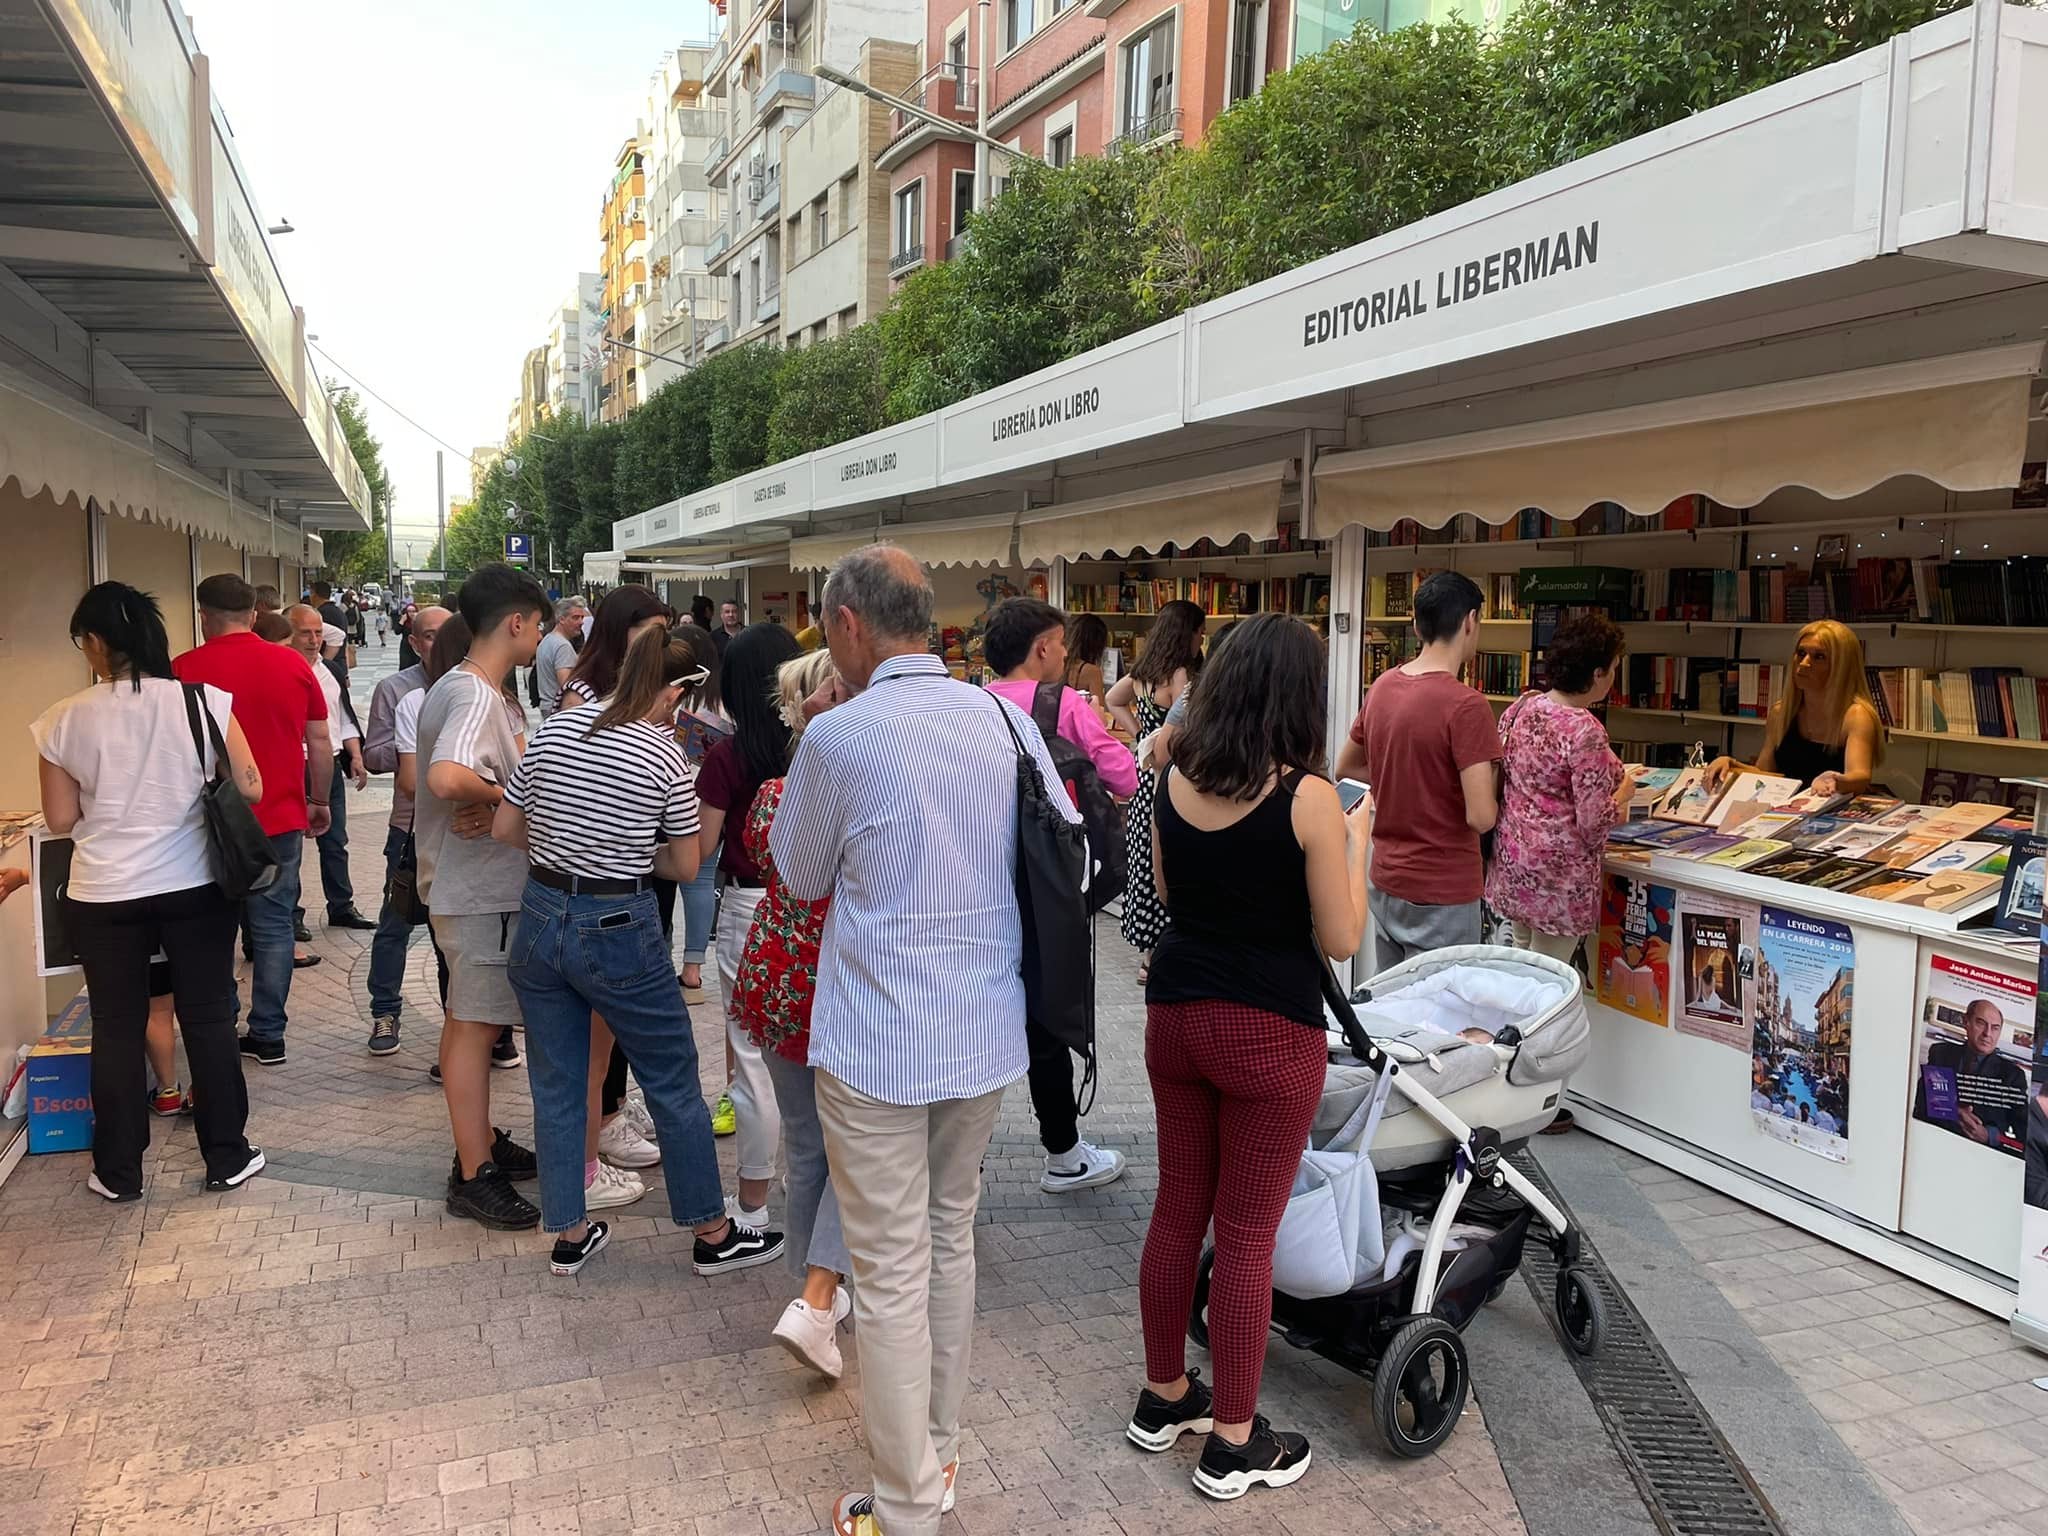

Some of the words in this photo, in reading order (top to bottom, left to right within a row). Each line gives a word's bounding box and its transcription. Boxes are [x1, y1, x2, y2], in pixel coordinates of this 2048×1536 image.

[1304, 279, 1427, 347] EDITORIAL
[1436, 220, 1599, 309] LIBERMAN
[992, 406, 1036, 442] LIBRERÍA
[1039, 399, 1061, 429] DON
[1065, 387, 1100, 420] LIBRO
[841, 456, 865, 482] LIBRERÍA
[865, 458, 878, 476] DON
[878, 452, 897, 472] LIBRO
[511, 537, 522, 552] P
[1537, 581, 1589, 592] salamandra
[1627, 879, 1648, 906] 35
[1696, 929, 1705, 938] LA
[1787, 919, 1826, 934] LEYENDO
[1696, 938, 1708, 947] DEL
[1762, 928, 1774, 937] EN
[1775, 931, 1786, 940] LA
[1787, 934, 1826, 948] CARRERA
[1829, 942, 1851, 953] 2019
[1949, 963, 1968, 974] José
[1970, 969, 2001, 983] Antonio
[2003, 978, 2032, 992] Marina
